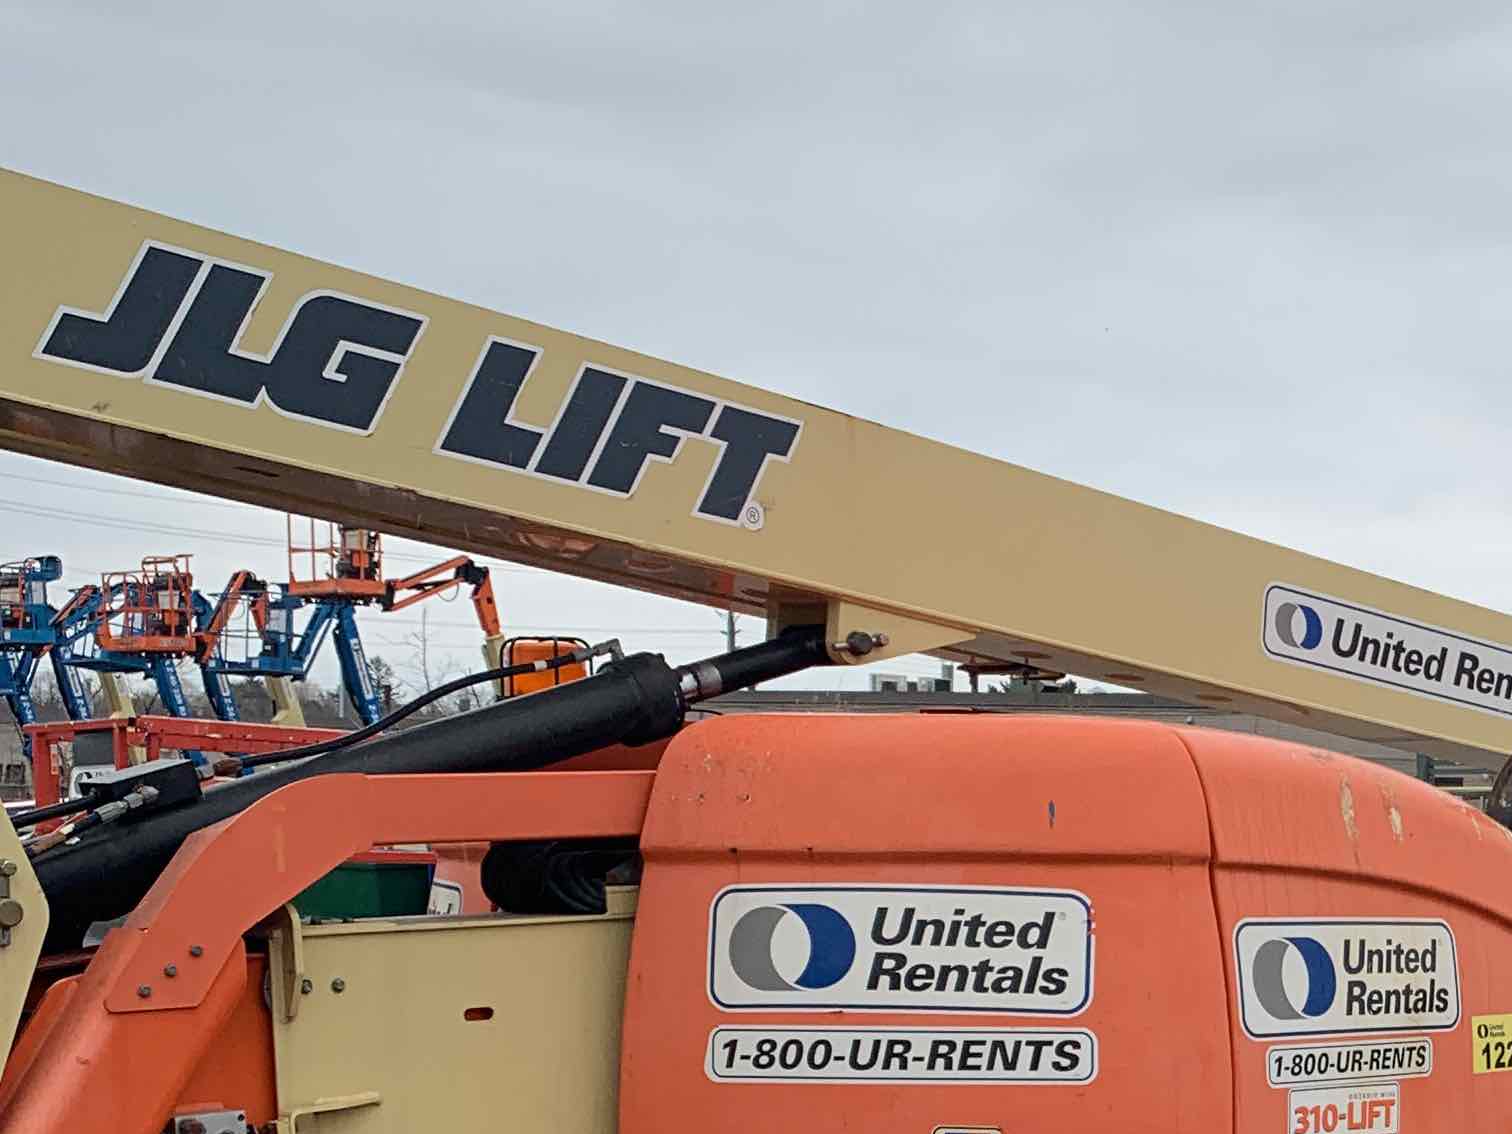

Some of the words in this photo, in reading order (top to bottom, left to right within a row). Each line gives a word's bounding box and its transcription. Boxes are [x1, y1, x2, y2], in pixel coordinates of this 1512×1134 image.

[35, 241, 428, 434] JLG
[434, 337, 803, 524] LIFT
[1332, 618, 1448, 681] United
[870, 906, 1056, 949] United
[866, 951, 1069, 996] Rentals
[1343, 939, 1437, 974] United
[1346, 979, 1449, 1016] Rentals
[721, 1038, 1082, 1073] 1-800-UR-RENTS
[1273, 1045, 1426, 1078] 1-800-UR-RENTS
